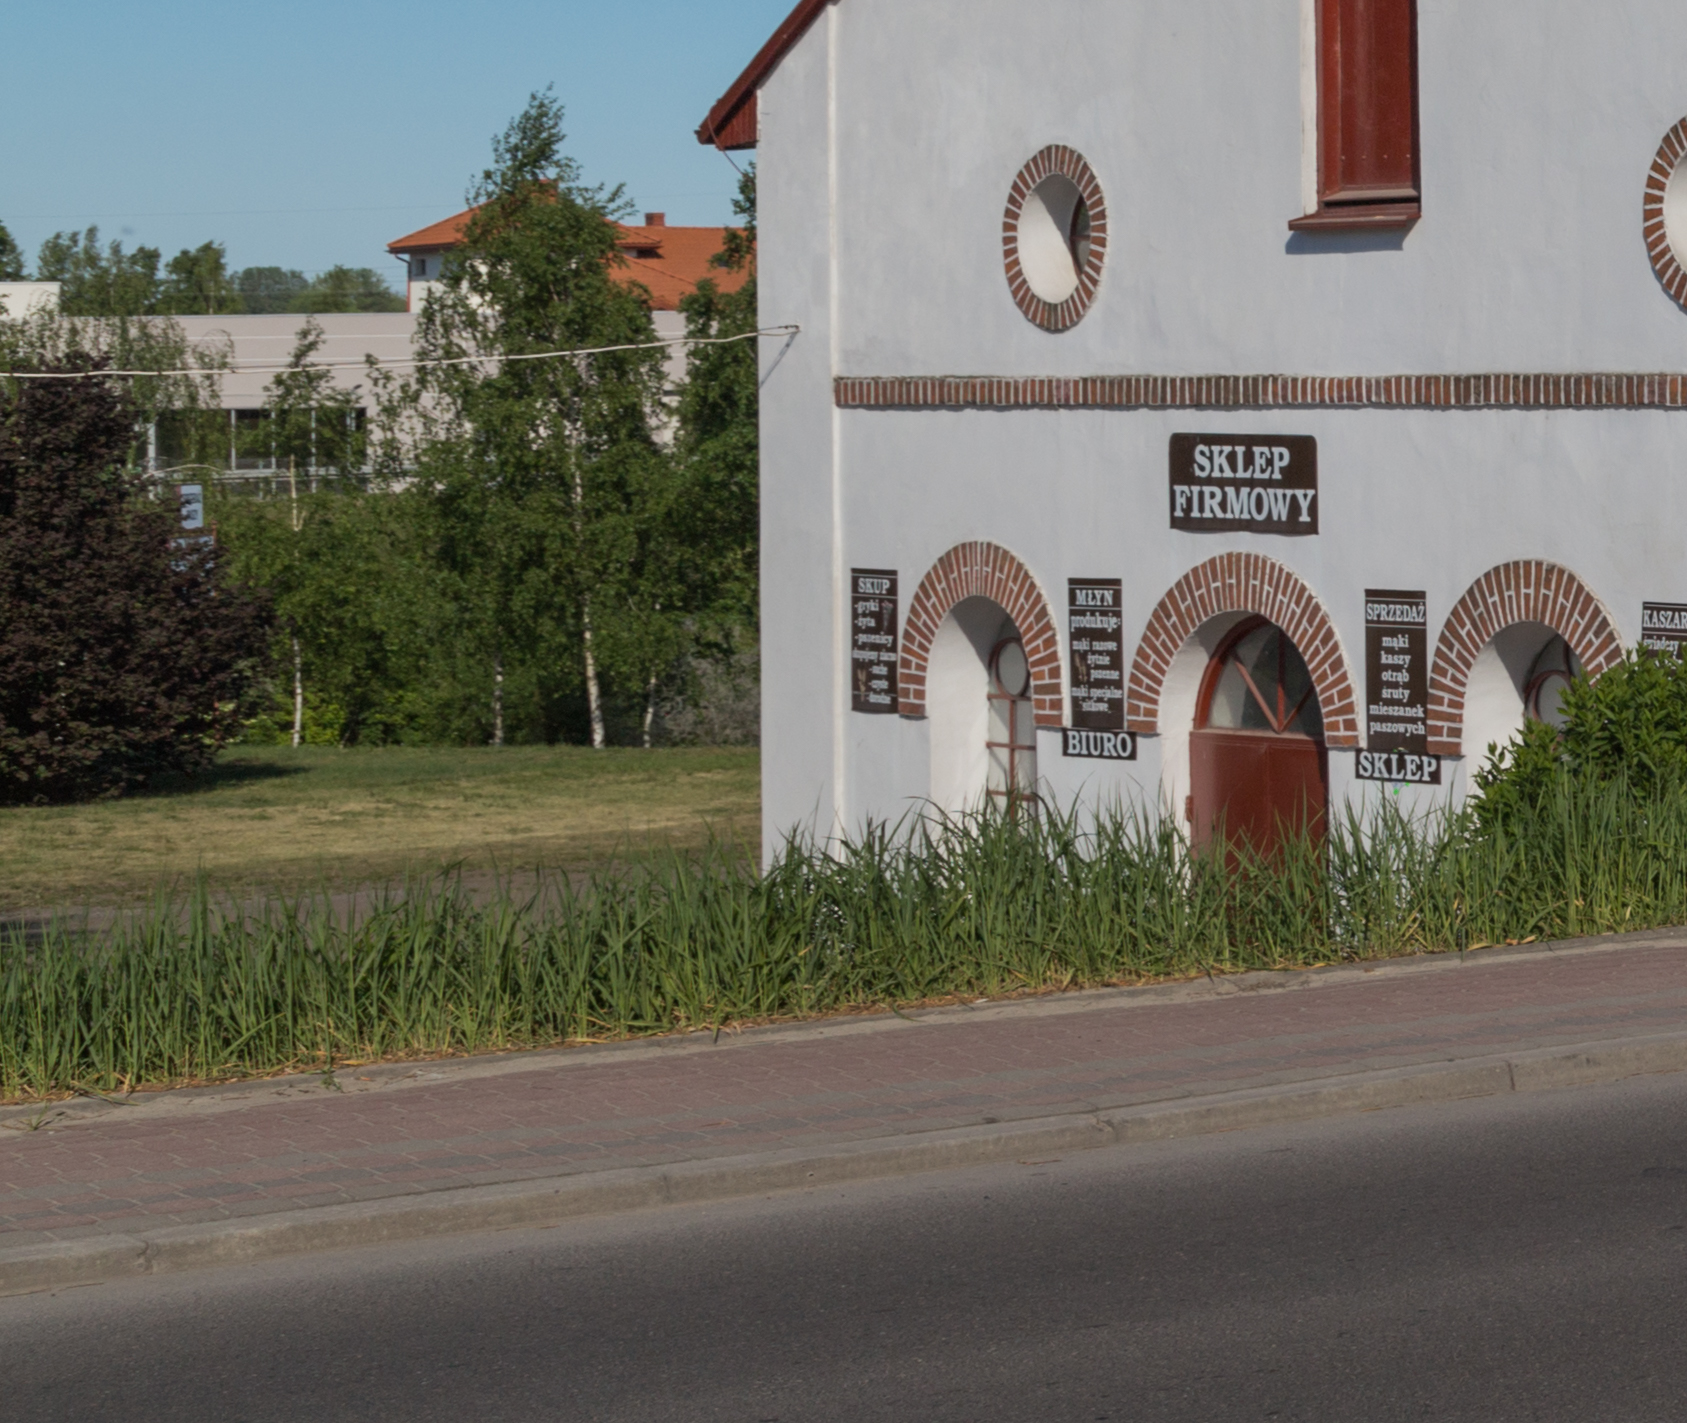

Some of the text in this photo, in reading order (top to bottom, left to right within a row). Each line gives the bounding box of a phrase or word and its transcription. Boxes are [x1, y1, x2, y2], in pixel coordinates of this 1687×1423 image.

[1193, 444, 1290, 479] SKLEP
[1173, 485, 1315, 522] FIRMOWY
[858, 577, 890, 594] SKUP
[1075, 589, 1114, 606] MŁYN
[1366, 602, 1425, 622] SPRZEDAŻ
[1382, 634, 1409, 650] mąki
[1380, 650, 1411, 668] kaszy
[1381, 669, 1410, 685] otrąb
[1382, 686, 1410, 702] śruty
[1369, 702, 1425, 717] mieszanek
[1369, 721, 1425, 736] paszowych
[1066, 731, 1132, 757] BIURO
[1358, 751, 1437, 781] SKLEP
